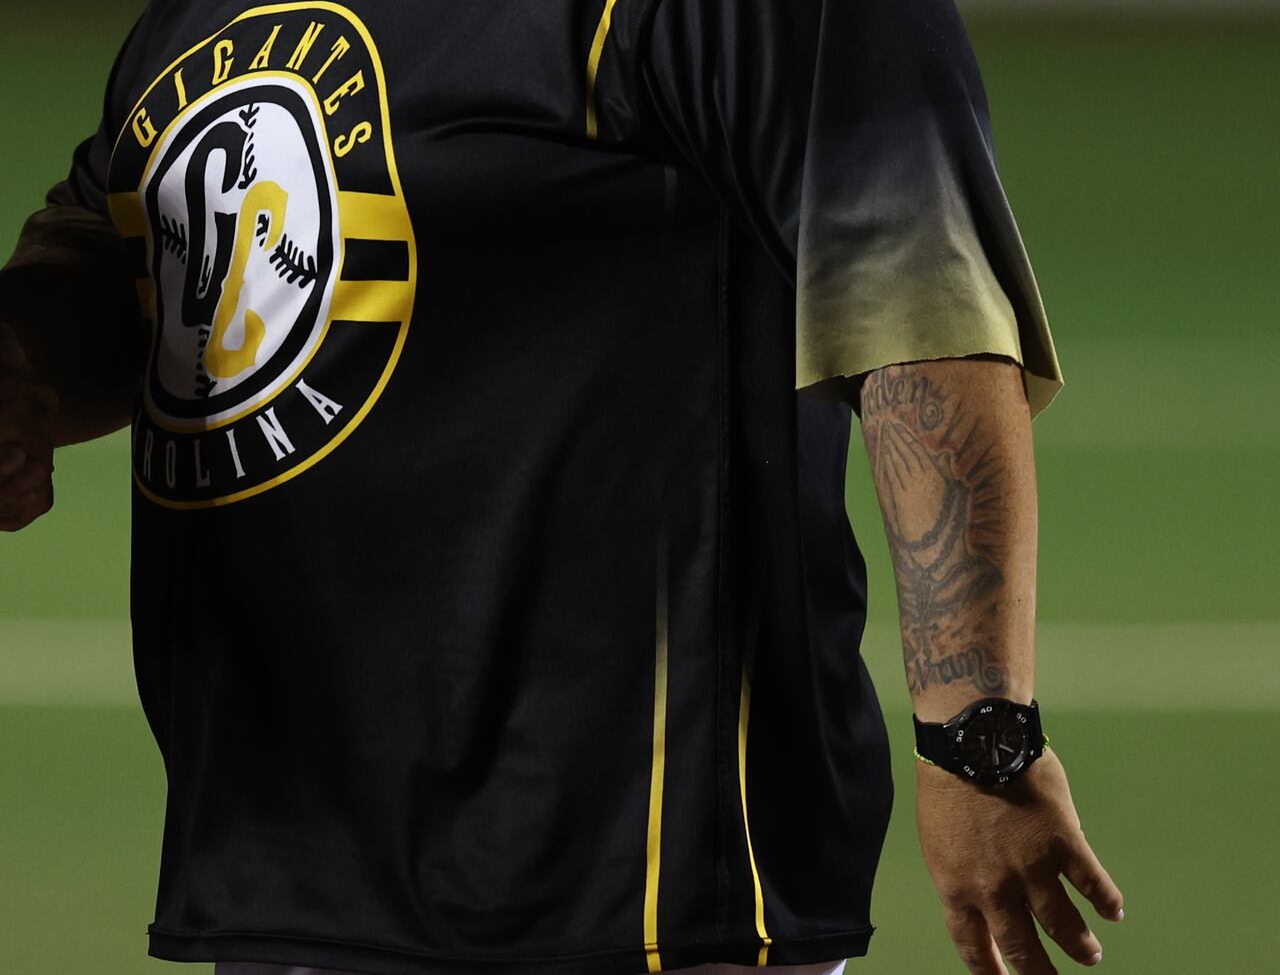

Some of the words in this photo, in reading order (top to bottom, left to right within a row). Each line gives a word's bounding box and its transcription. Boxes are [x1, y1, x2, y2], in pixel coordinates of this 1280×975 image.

[132, 21, 372, 158] GIGANTES
[133, 379, 343, 489] ROLINA
[980, 706, 993, 714] 40
